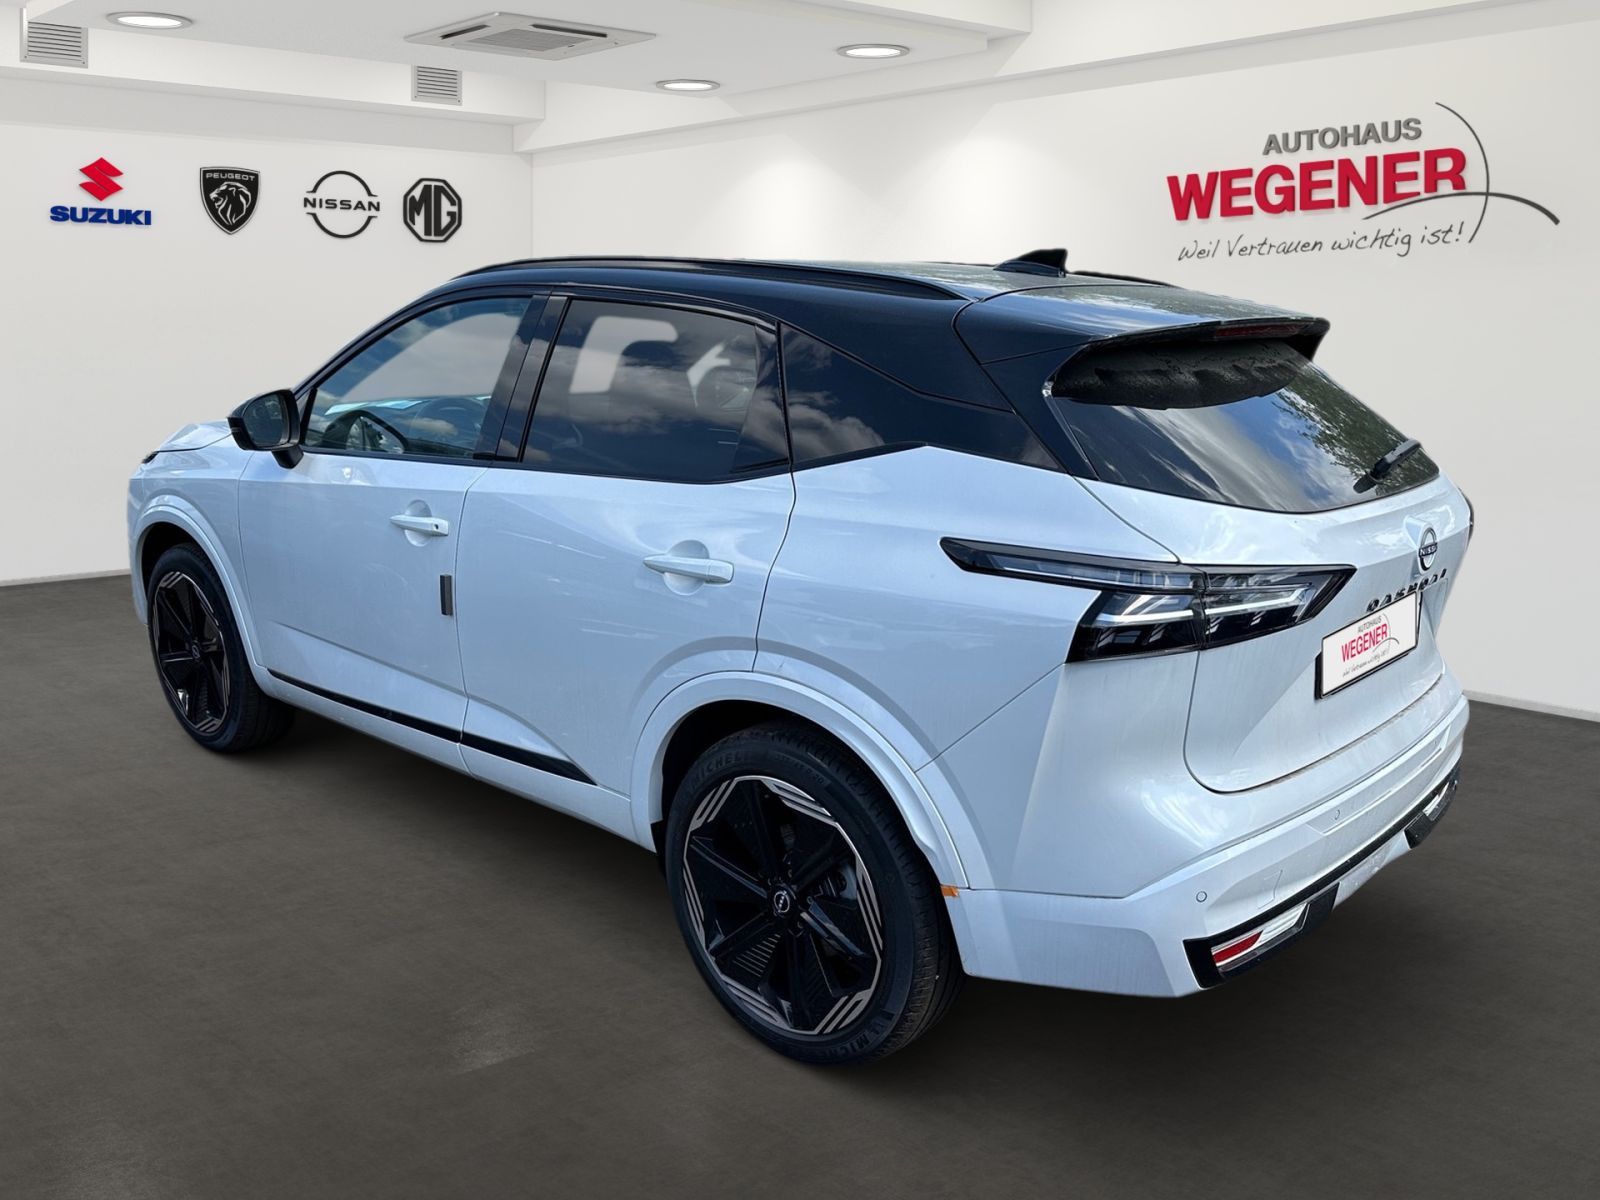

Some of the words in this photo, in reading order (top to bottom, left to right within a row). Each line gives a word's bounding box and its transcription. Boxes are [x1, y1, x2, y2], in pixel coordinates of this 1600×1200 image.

[1262, 117, 1422, 155] AUTOHAUS
[205, 171, 256, 182] PEUGEOT
[1167, 148, 1467, 221] WEGENER
[50, 205, 152, 226] SUZUKI
[303, 196, 380, 212] NISSAN
[409, 184, 457, 238] MG
[1178, 239, 1220, 262] Weil
[1227, 234, 1323, 258] Vertrauen
[1331, 227, 1412, 257] wichtig
[1420, 221, 1465, 245] ist!
[1341, 623, 1388, 662] WEGENER
